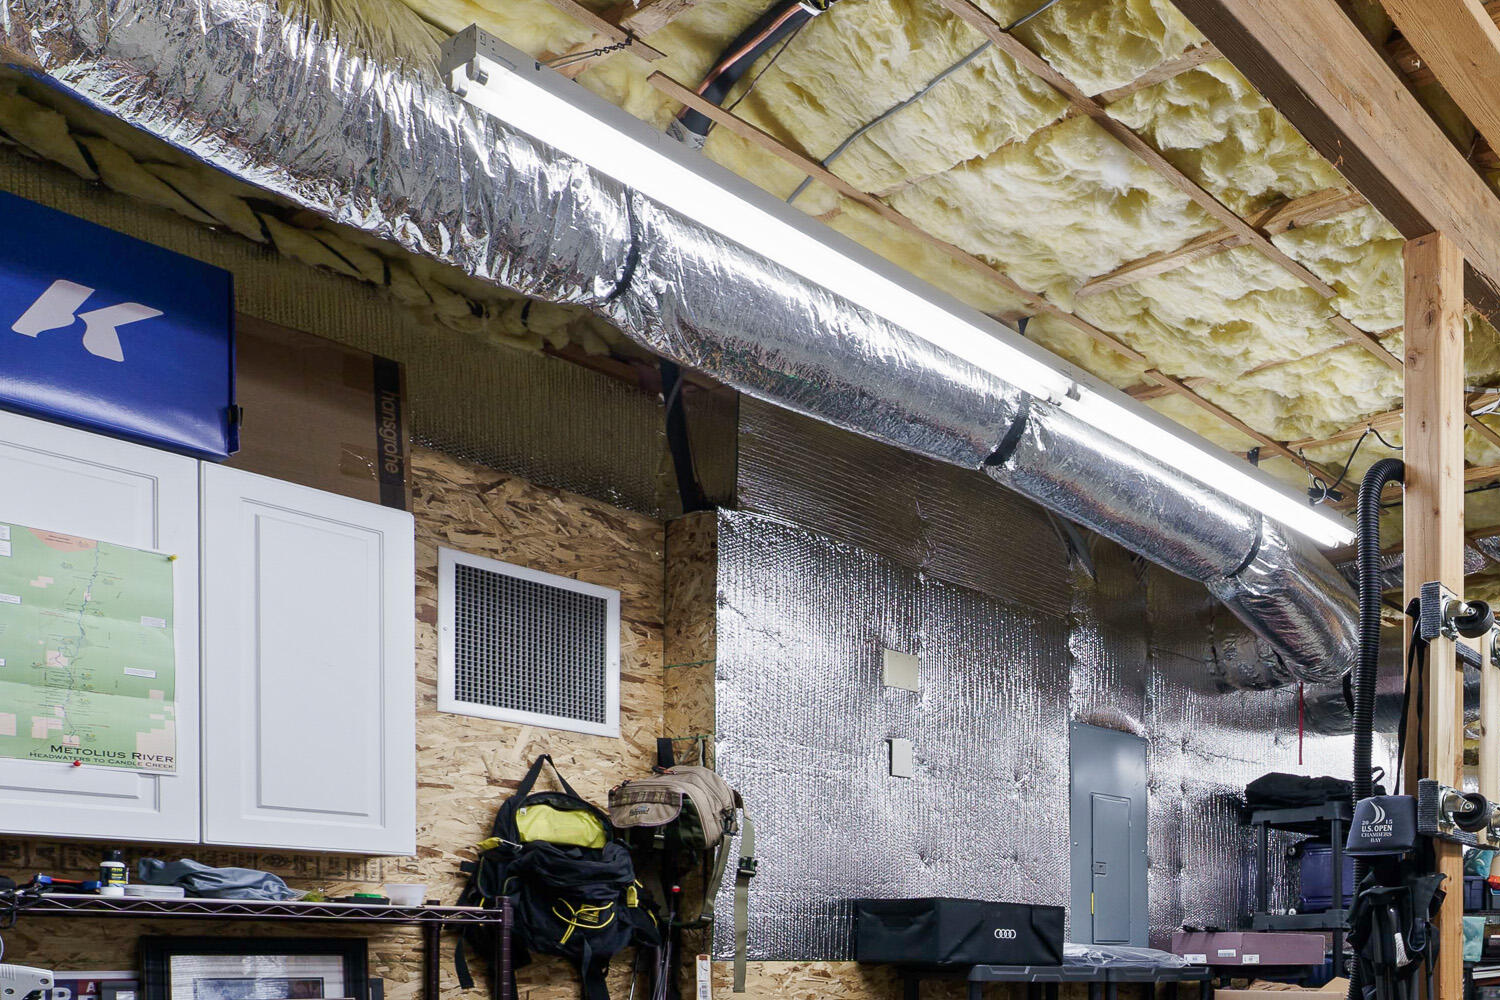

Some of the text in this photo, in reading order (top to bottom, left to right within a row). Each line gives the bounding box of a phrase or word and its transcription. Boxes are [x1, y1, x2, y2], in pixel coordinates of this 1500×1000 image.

[379, 389, 402, 474] hansgrohe
[29, 751, 91, 762] HEADWATERS
[108, 758, 143, 767] CANDLE
[50, 744, 174, 763] METOLIUS RIVER
